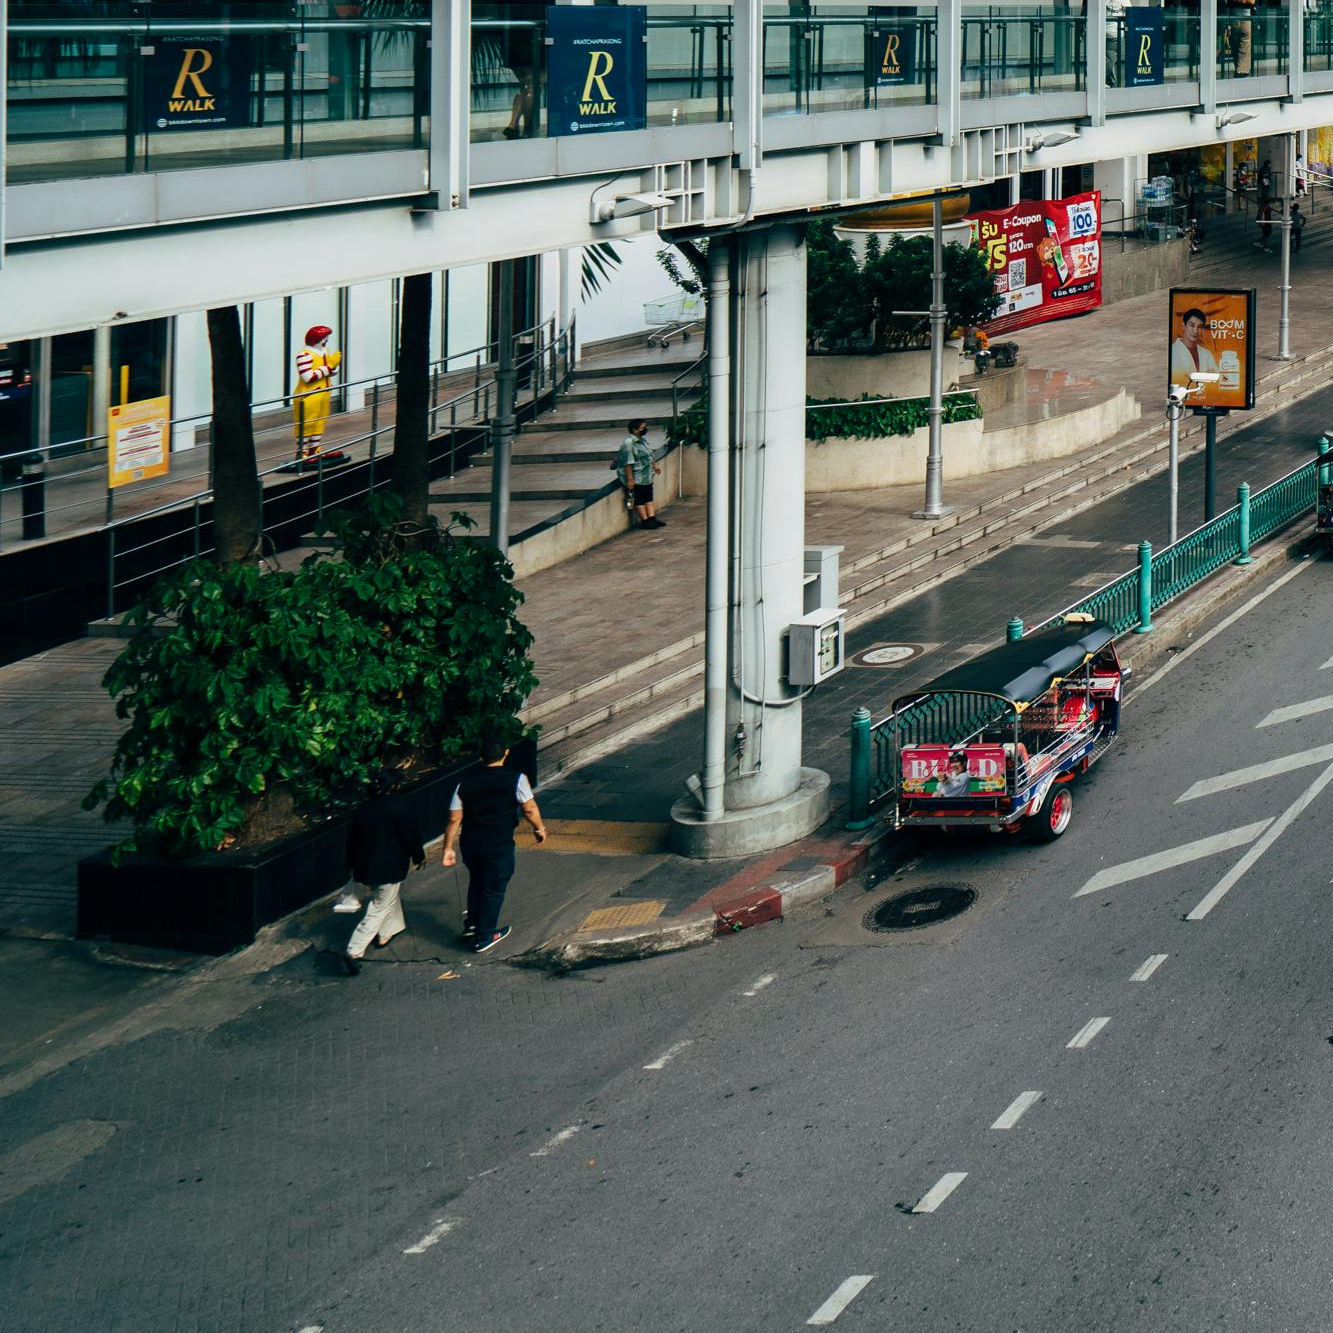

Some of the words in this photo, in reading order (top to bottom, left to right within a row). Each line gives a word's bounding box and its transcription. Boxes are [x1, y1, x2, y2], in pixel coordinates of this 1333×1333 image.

[883, 34, 900, 66] R
[1137, 34, 1151, 66] R
[172, 48, 213, 98] R
[581, 51, 615, 102] R
[881, 66, 901, 75] WALK
[1136, 66, 1152, 75] WALK
[168, 98, 216, 112] WALK
[578, 101, 617, 116] WALK
[981, 220, 998, 240] รับ
[1003, 213, 1042, 230] E-Coupon
